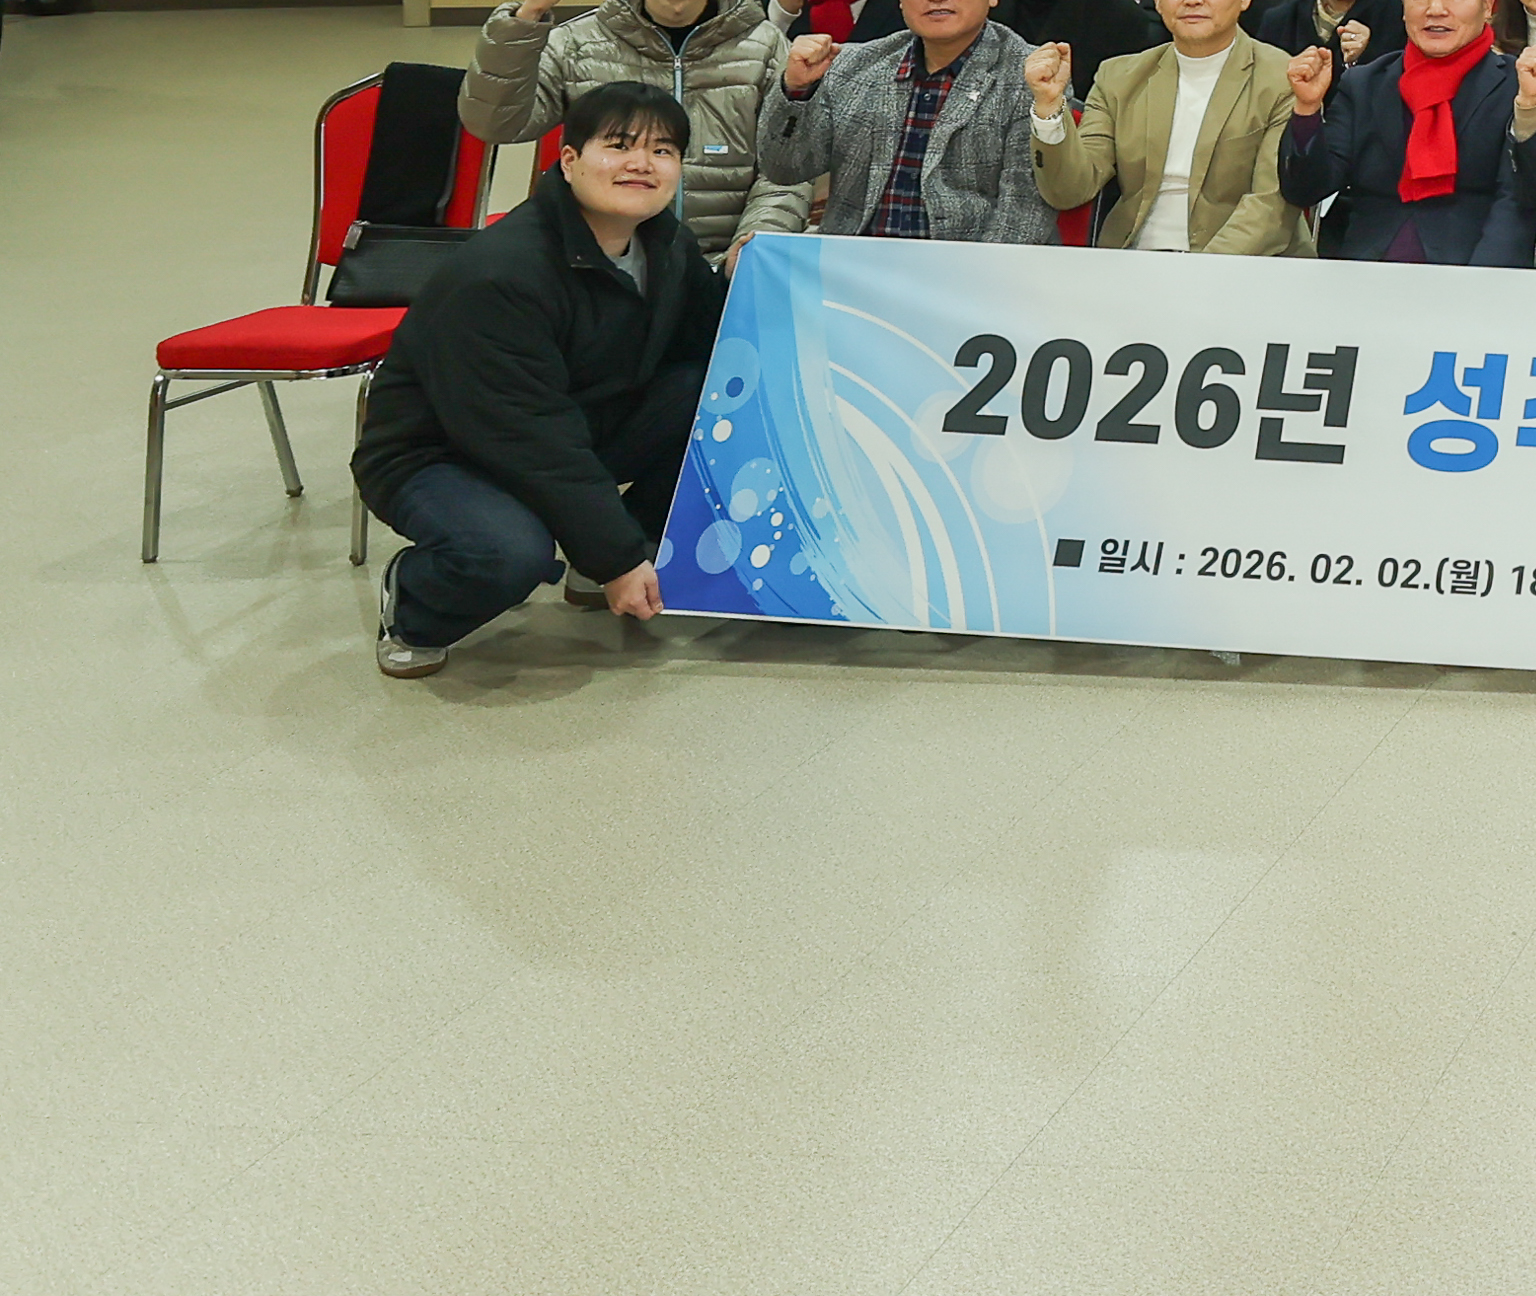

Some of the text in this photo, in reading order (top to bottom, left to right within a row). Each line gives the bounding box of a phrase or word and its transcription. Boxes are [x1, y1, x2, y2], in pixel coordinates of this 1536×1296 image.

[941, 333, 1359, 465] 2026년
[1097, 537, 1165, 576] 일시
[1197, 546, 1296, 582] 2026.
[1310, 553, 1364, 586] 02.
[1377, 557, 1495, 598] 02.(월)
